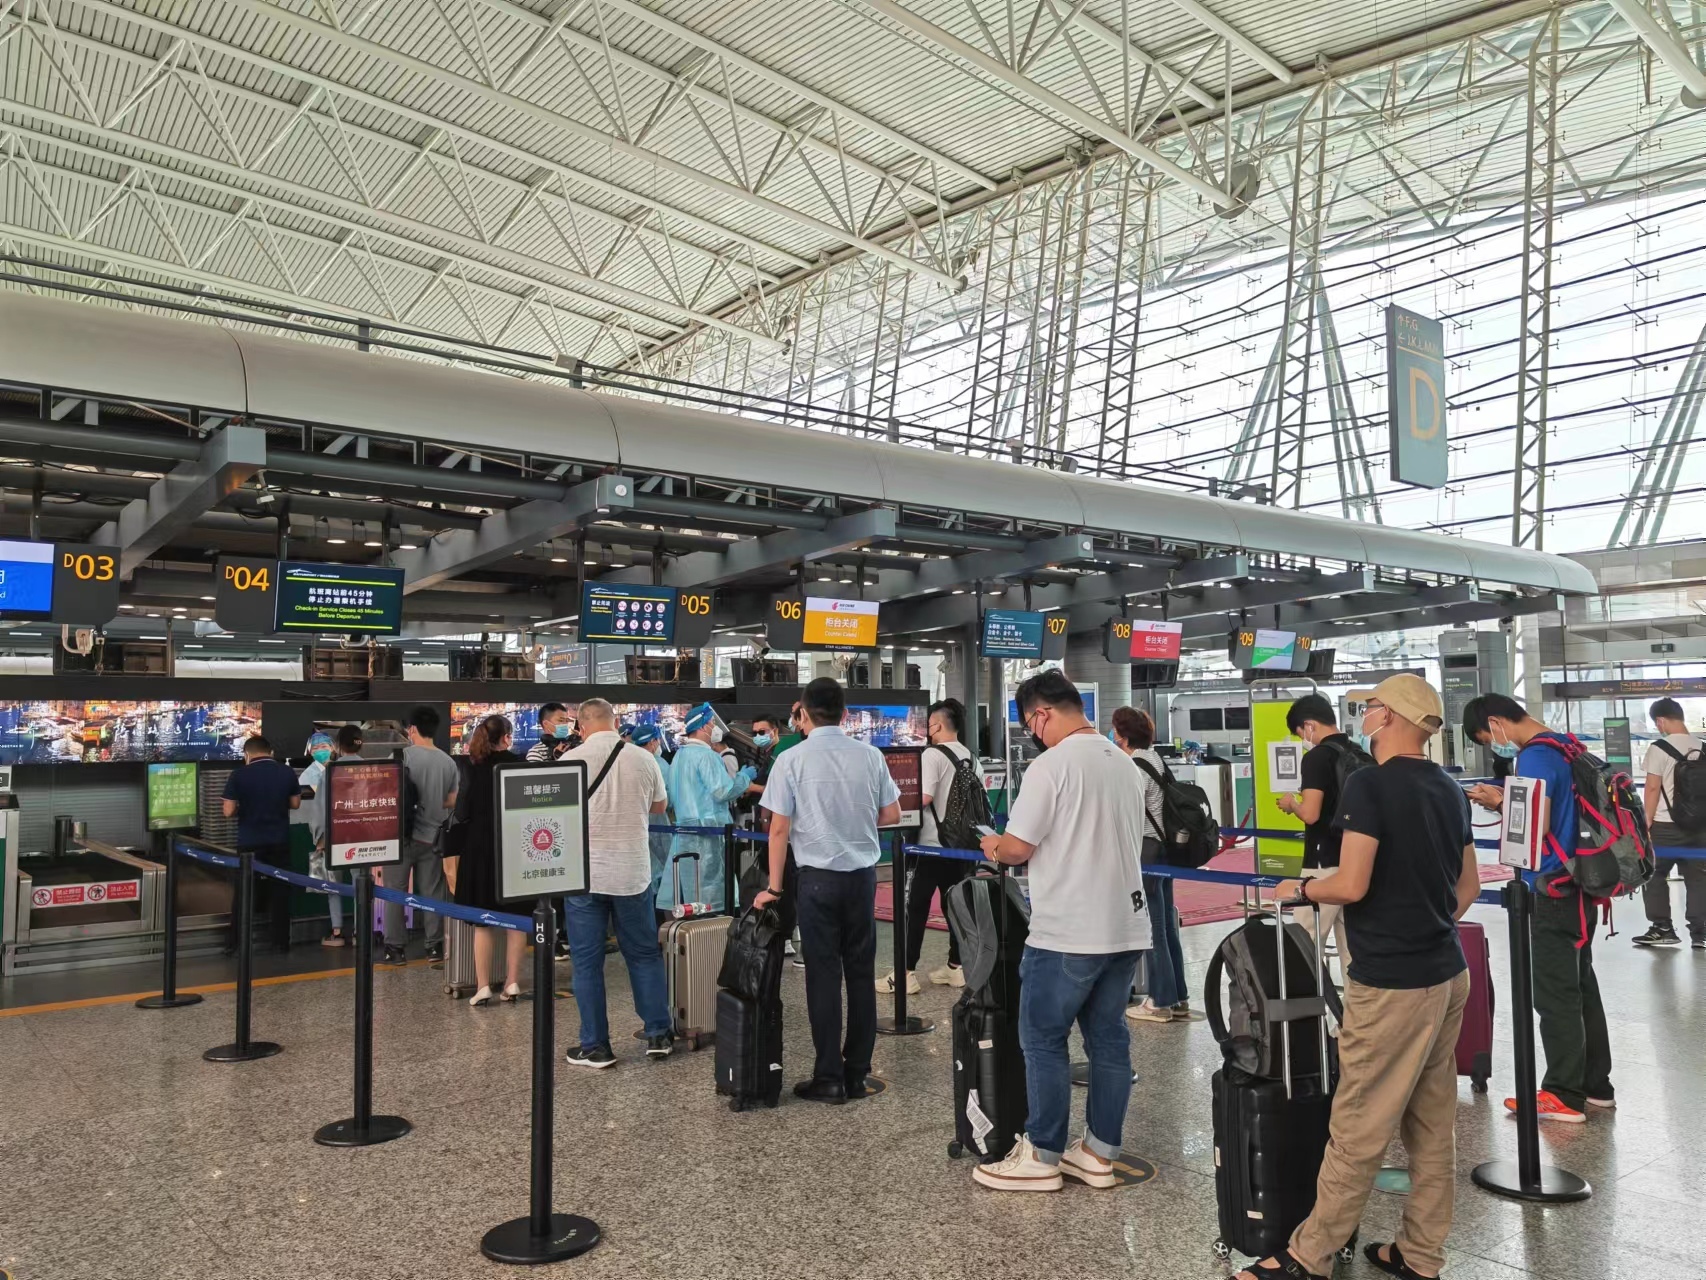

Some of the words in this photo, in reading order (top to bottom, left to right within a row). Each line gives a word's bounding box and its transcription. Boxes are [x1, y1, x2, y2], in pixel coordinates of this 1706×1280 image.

[1409, 367, 1440, 440] D
[63, 553, 115, 581] D03
[225, 565, 270, 592] D04
[681, 594, 710, 615] D05
[776, 600, 802, 619] D06
[825, 617, 859, 629] 柜台关闭
[1047, 618, 1067, 635] D07
[1112, 622, 1132, 638] D08
[523, 784, 561, 795] 温馨提示
[522, 867, 566, 880] 北京健康宝
